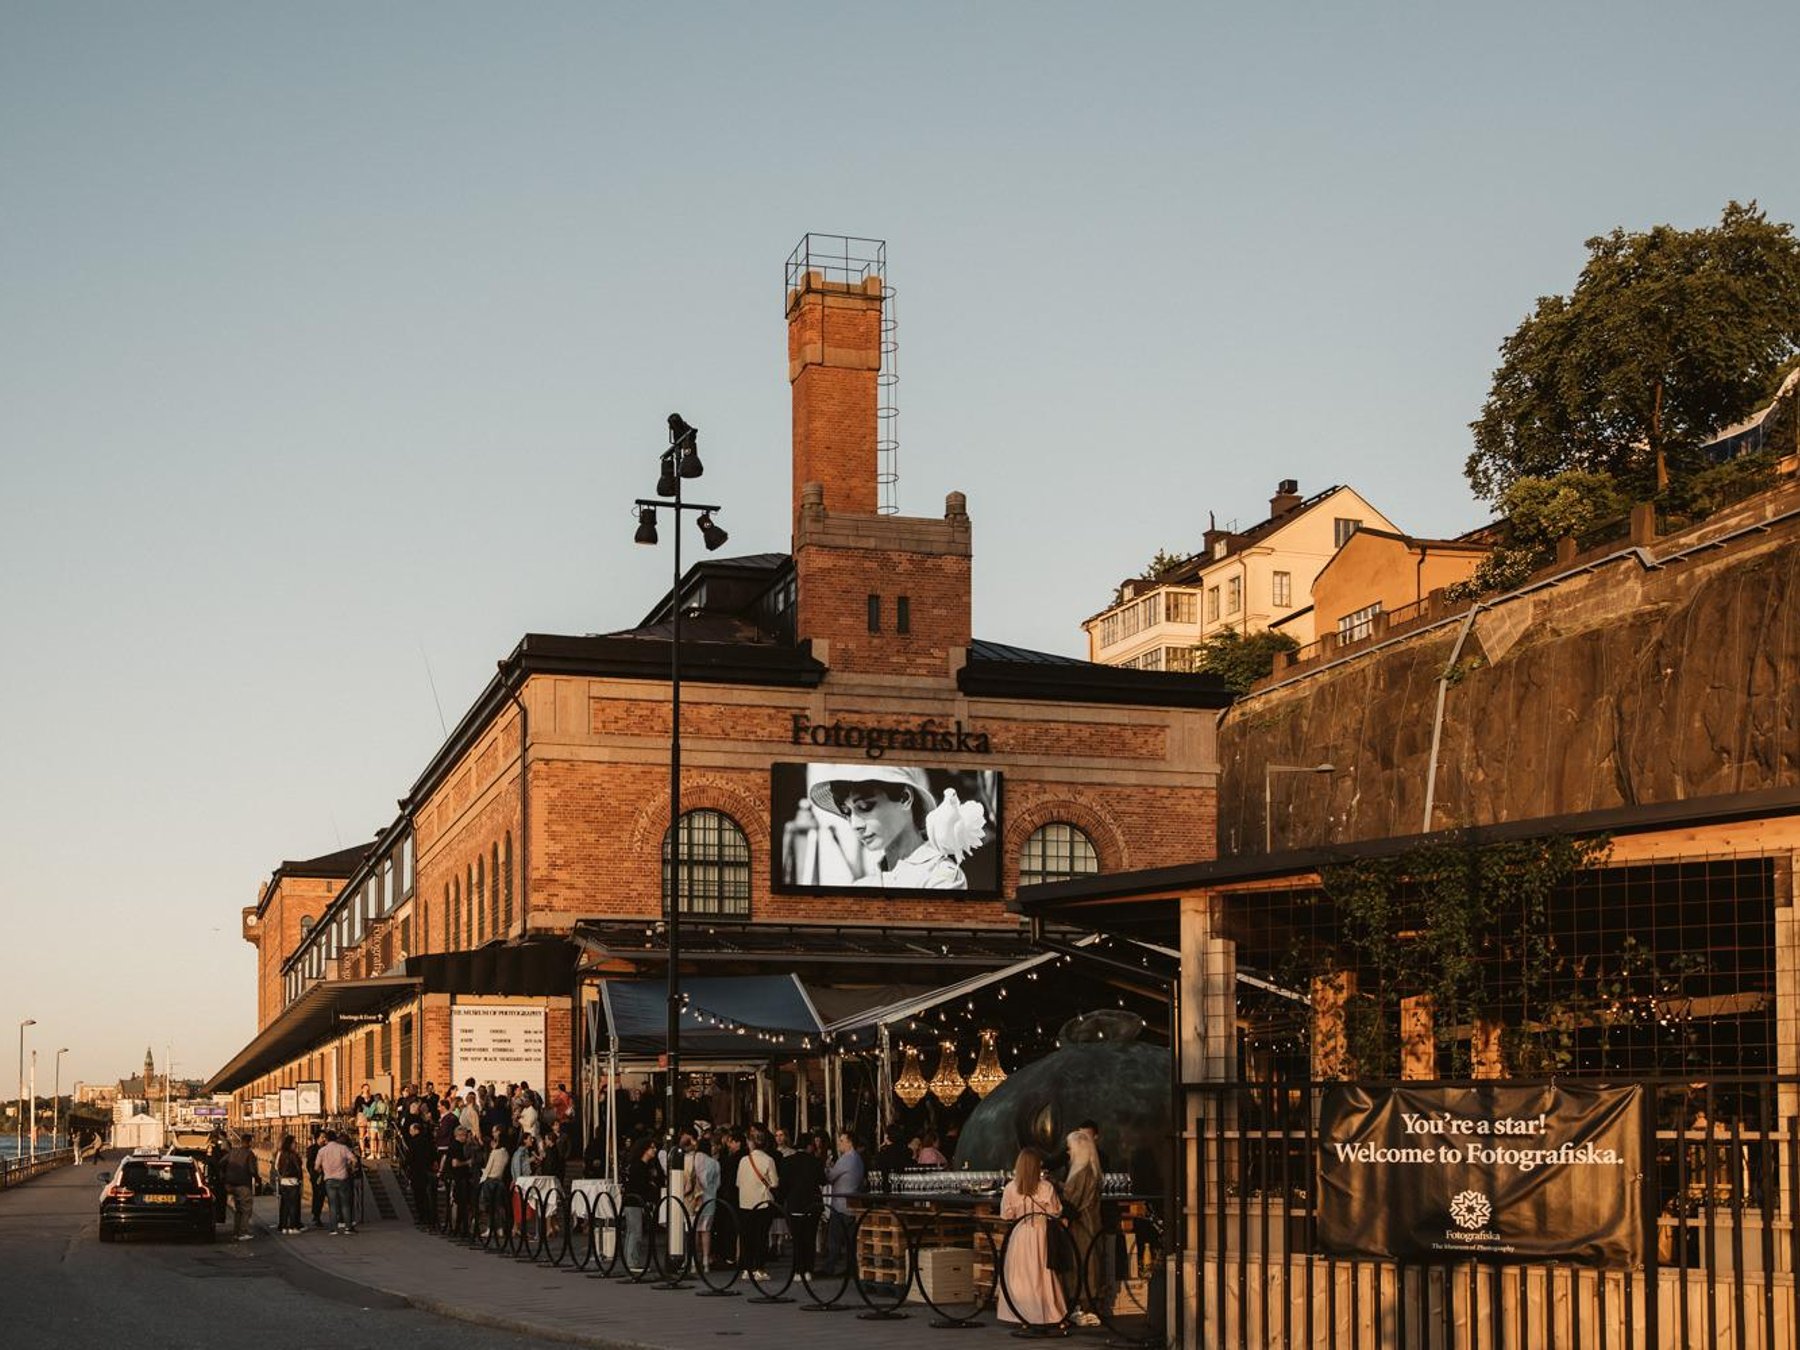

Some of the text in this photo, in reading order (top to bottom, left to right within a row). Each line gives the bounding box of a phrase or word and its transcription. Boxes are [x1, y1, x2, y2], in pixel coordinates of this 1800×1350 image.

[790, 713, 992, 760] Fotografiska
[1401, 1113, 1546, 1135] You’re a star!
[1334, 1142, 1625, 1171] Welcome to Fotografiska.
[1446, 1230, 1500, 1243] Fotografiska
[1477, 1244, 1515, 1253] Photography
